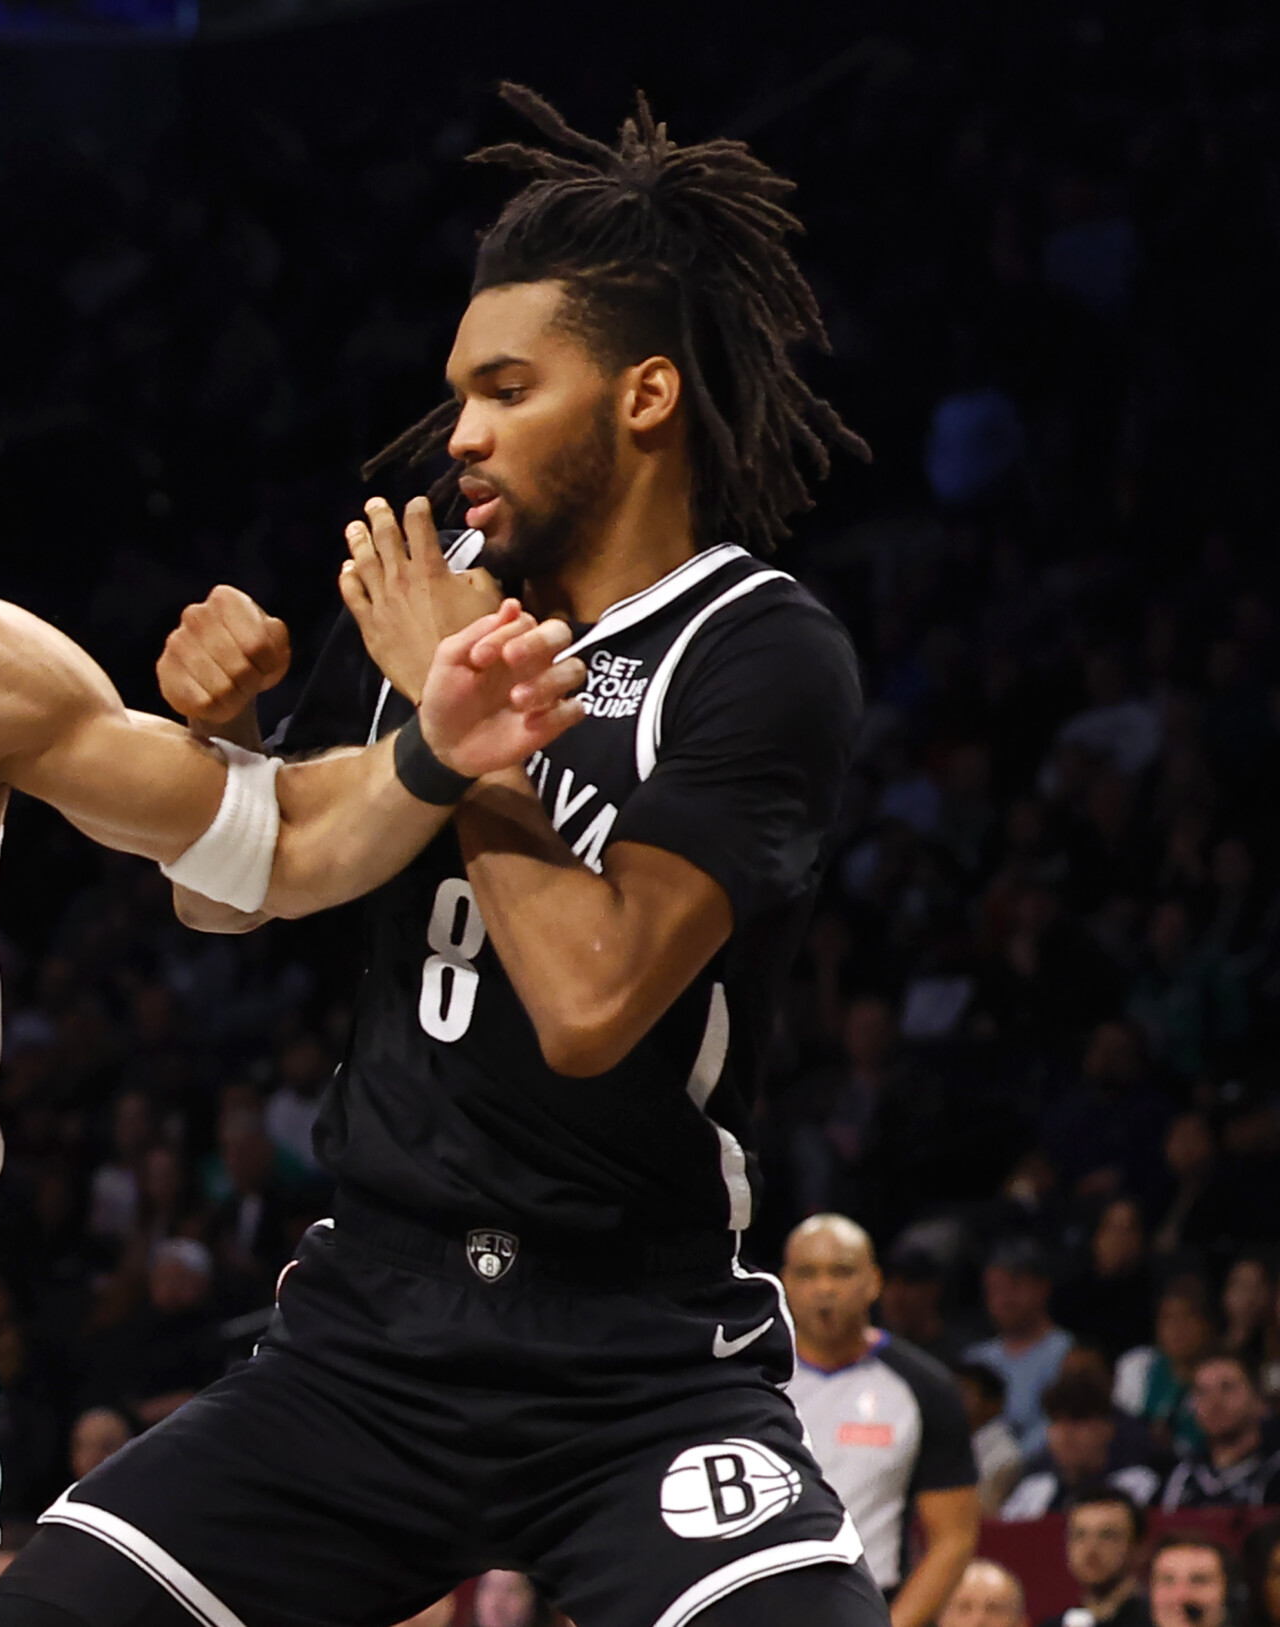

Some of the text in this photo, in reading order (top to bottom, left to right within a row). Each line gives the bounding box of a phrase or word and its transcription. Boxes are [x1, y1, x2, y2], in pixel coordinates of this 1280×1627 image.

[591, 649, 644, 679] GET
[585, 669, 649, 699] YOUR
[575, 692, 642, 718] GUIDE
[418, 877, 487, 1044] 8
[470, 1233, 514, 1257] NETS
[703, 1453, 757, 1525] B
